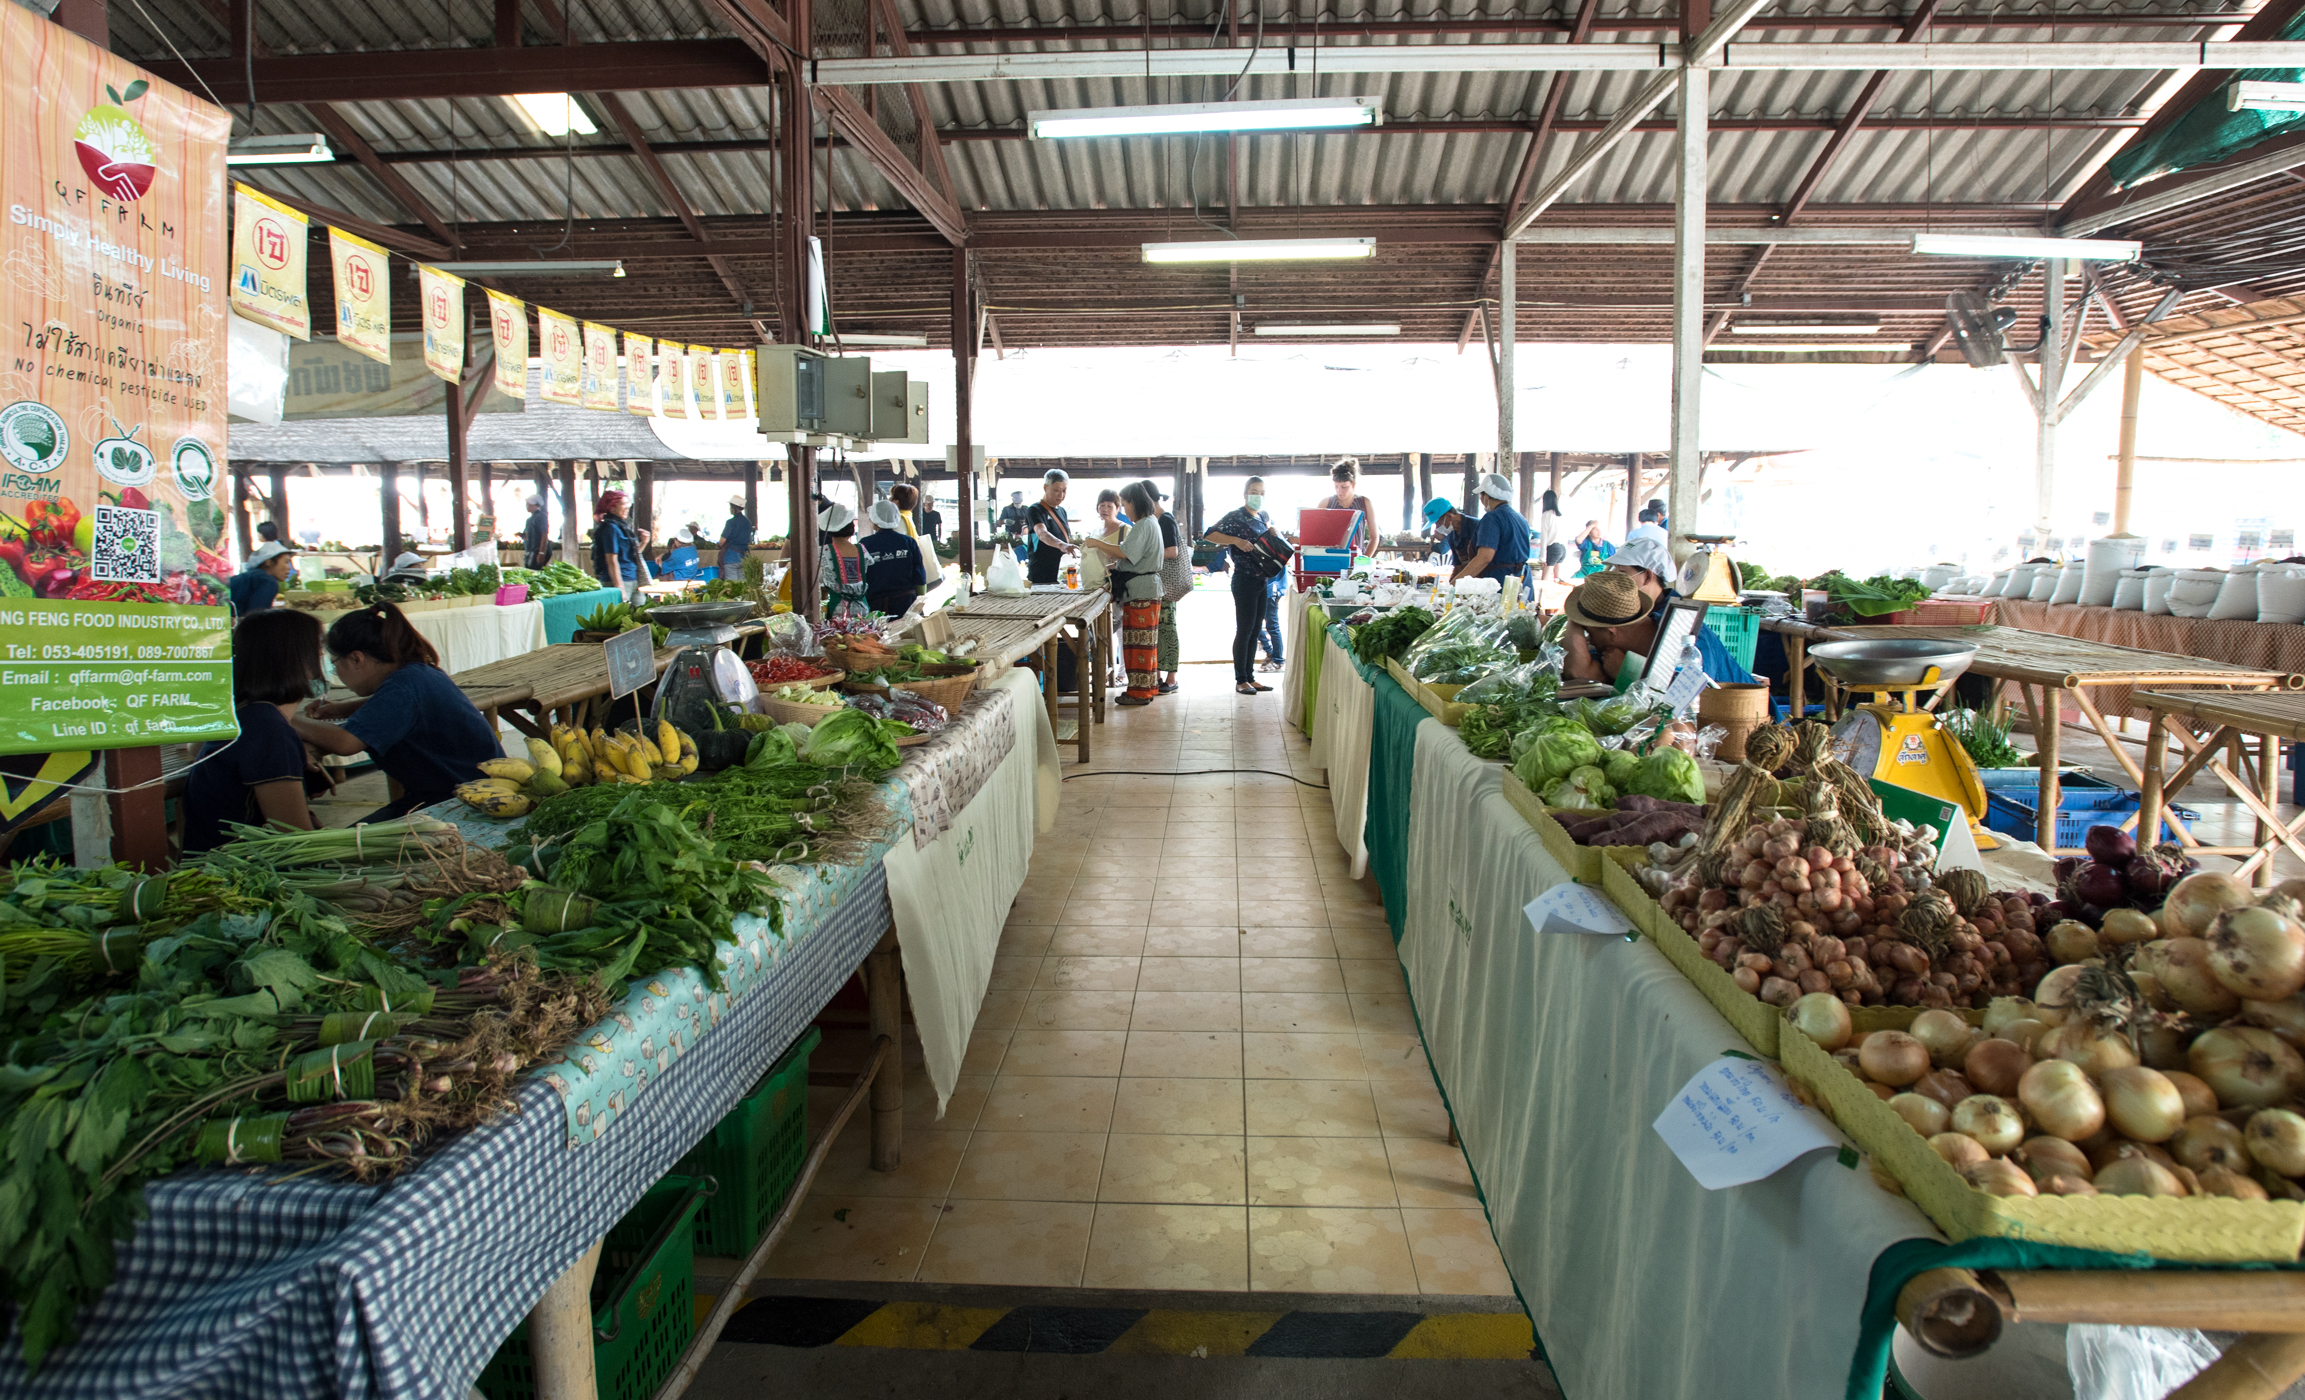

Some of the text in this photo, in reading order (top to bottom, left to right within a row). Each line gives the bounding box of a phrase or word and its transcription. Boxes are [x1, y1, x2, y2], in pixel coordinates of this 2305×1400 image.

[101, 199, 175, 239] FARM
[10, 204, 210, 292] Simply Healthy Living
[258, 225, 285, 262] เจ
[92, 272, 149, 309] อินทรีย์
[348, 262, 370, 295] เจ
[432, 294, 447, 322] เจ
[98, 310, 144, 334] Organic
[496, 316, 510, 341] เจ
[22, 322, 202, 388] ไม่ใช้สารเคมียาฆ่าแมลง
[553, 332, 566, 355] เจ
[14, 357, 208, 412] NO chemical pesticide USED
[2, 473, 61, 493] IFOAM
[0, 490, 60, 502] ACCREDITED
[0, 610, 226, 631] NG FENG FOOD INDUSTRY CO., LTD.
[6, 644, 214, 660] Tel: 053-405191, 089-7007867
[614, 638, 642, 683] 15
[2, 670, 49, 684] Email
[68, 669, 212, 686] qffarm@qf-farm.com
[32, 696, 109, 711] Facebook
[126, 694, 147, 708] QF
[152, 693, 190, 706] FARM
[52, 723, 87, 737] Line
[90, 722, 107, 734] ID
